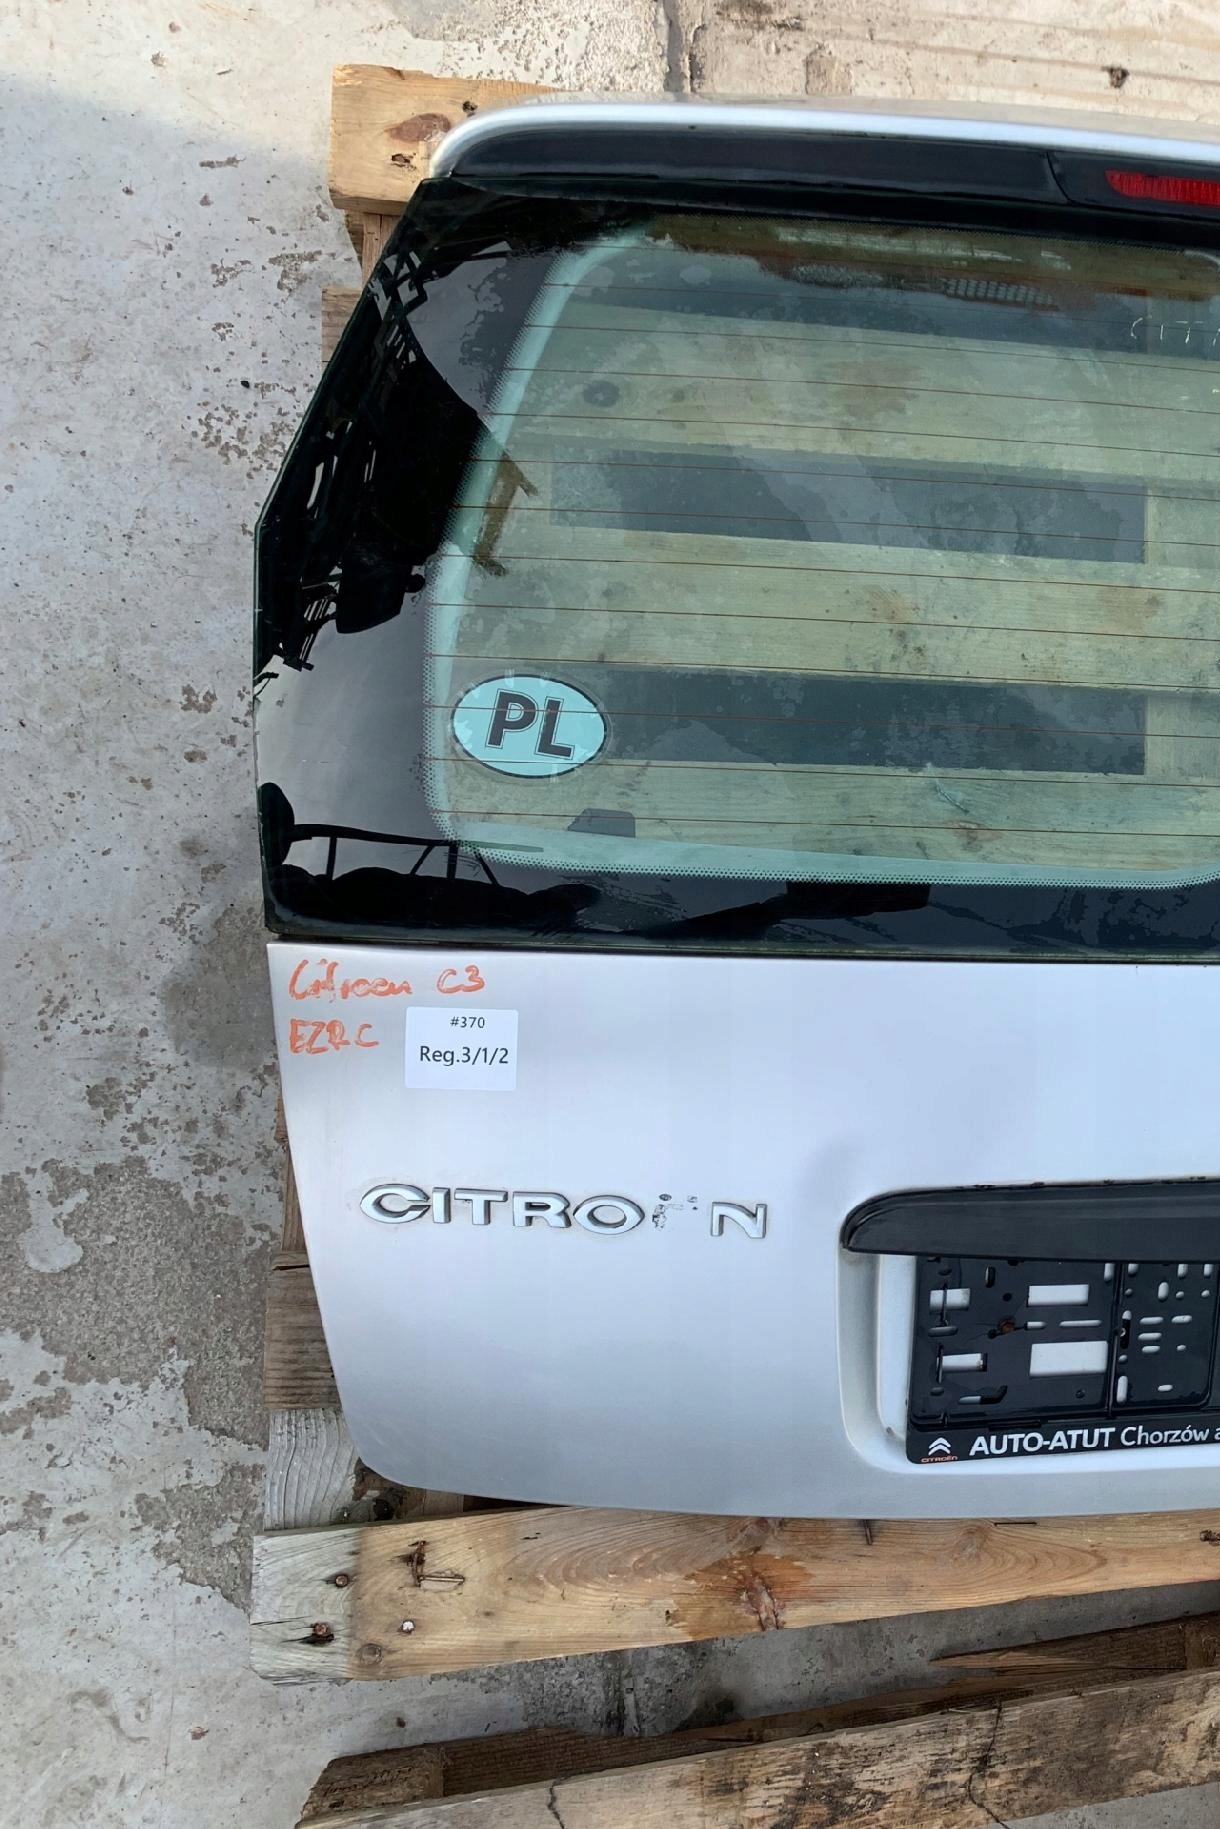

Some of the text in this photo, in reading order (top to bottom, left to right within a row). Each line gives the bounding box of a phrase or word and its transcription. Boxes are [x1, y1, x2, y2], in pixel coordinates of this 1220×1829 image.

[485, 688, 575, 760] PL
[437, 965, 486, 994] C3
[449, 1015, 486, 1029] #370
[419, 1045, 509, 1067] Reg.3/1/2
[360, 1183, 768, 1239] CITRON
[969, 1427, 1115, 1457] AUTO-ATUT
[1120, 1424, 1210, 1447] Chorzów
